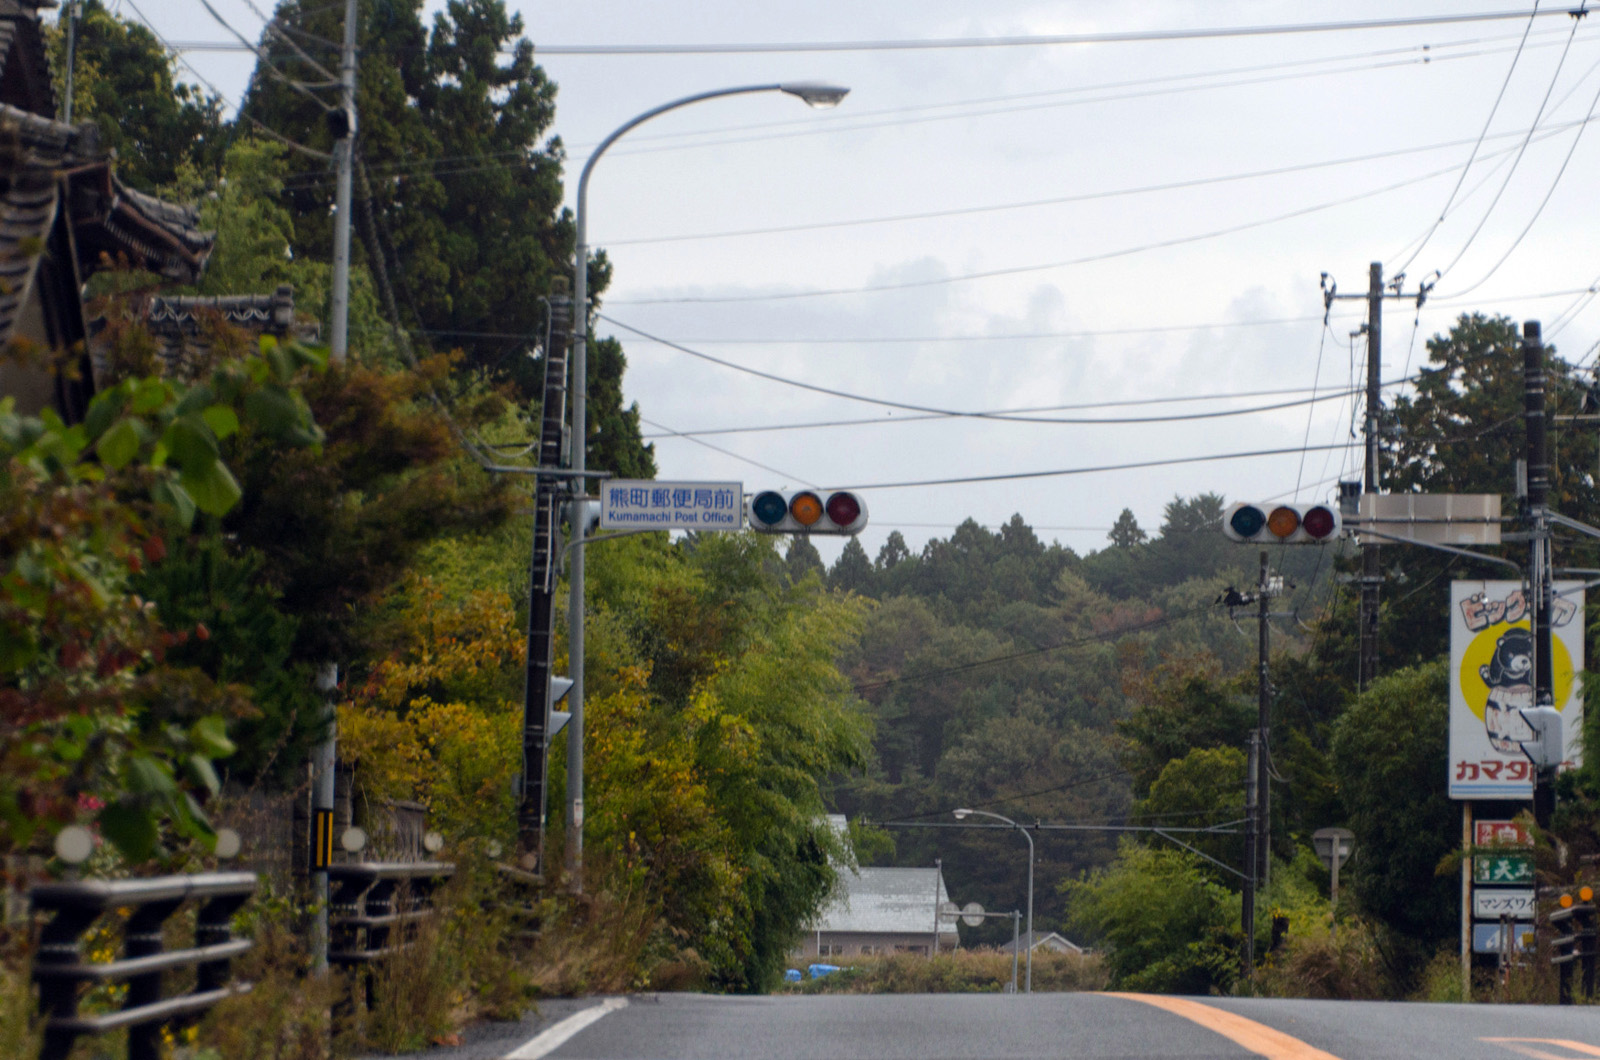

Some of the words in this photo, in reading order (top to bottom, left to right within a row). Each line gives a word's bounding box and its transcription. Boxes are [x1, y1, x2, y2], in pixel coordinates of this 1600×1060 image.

[609, 487, 734, 509] 熊町郵便局前
[608, 511, 671, 522] Kumamachi
[675, 512, 698, 522] Post
[702, 513, 734, 523] Office
